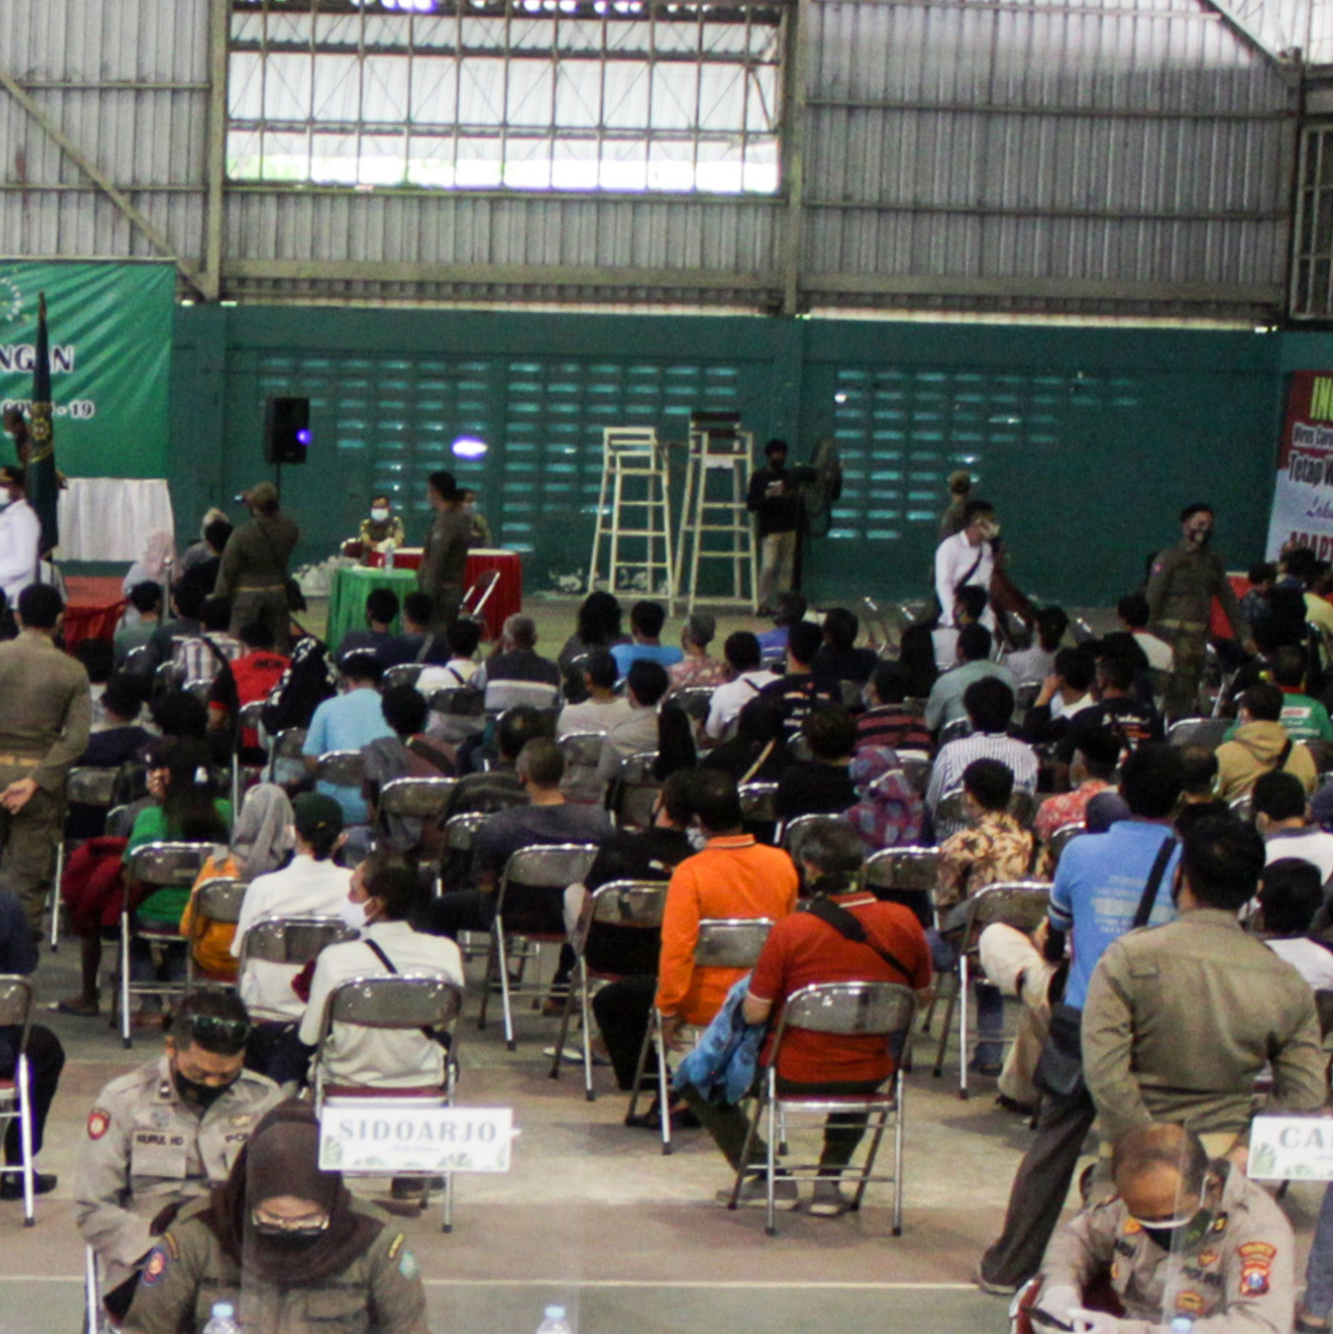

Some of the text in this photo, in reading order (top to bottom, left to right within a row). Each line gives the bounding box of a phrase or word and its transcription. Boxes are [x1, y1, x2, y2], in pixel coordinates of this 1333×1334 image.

[73, 402, 92, 416] 19
[1289, 452, 1321, 487] Tetap
[339, 1119, 497, 1142] SIDOARJO
[1279, 1126, 1333, 1150] CA
